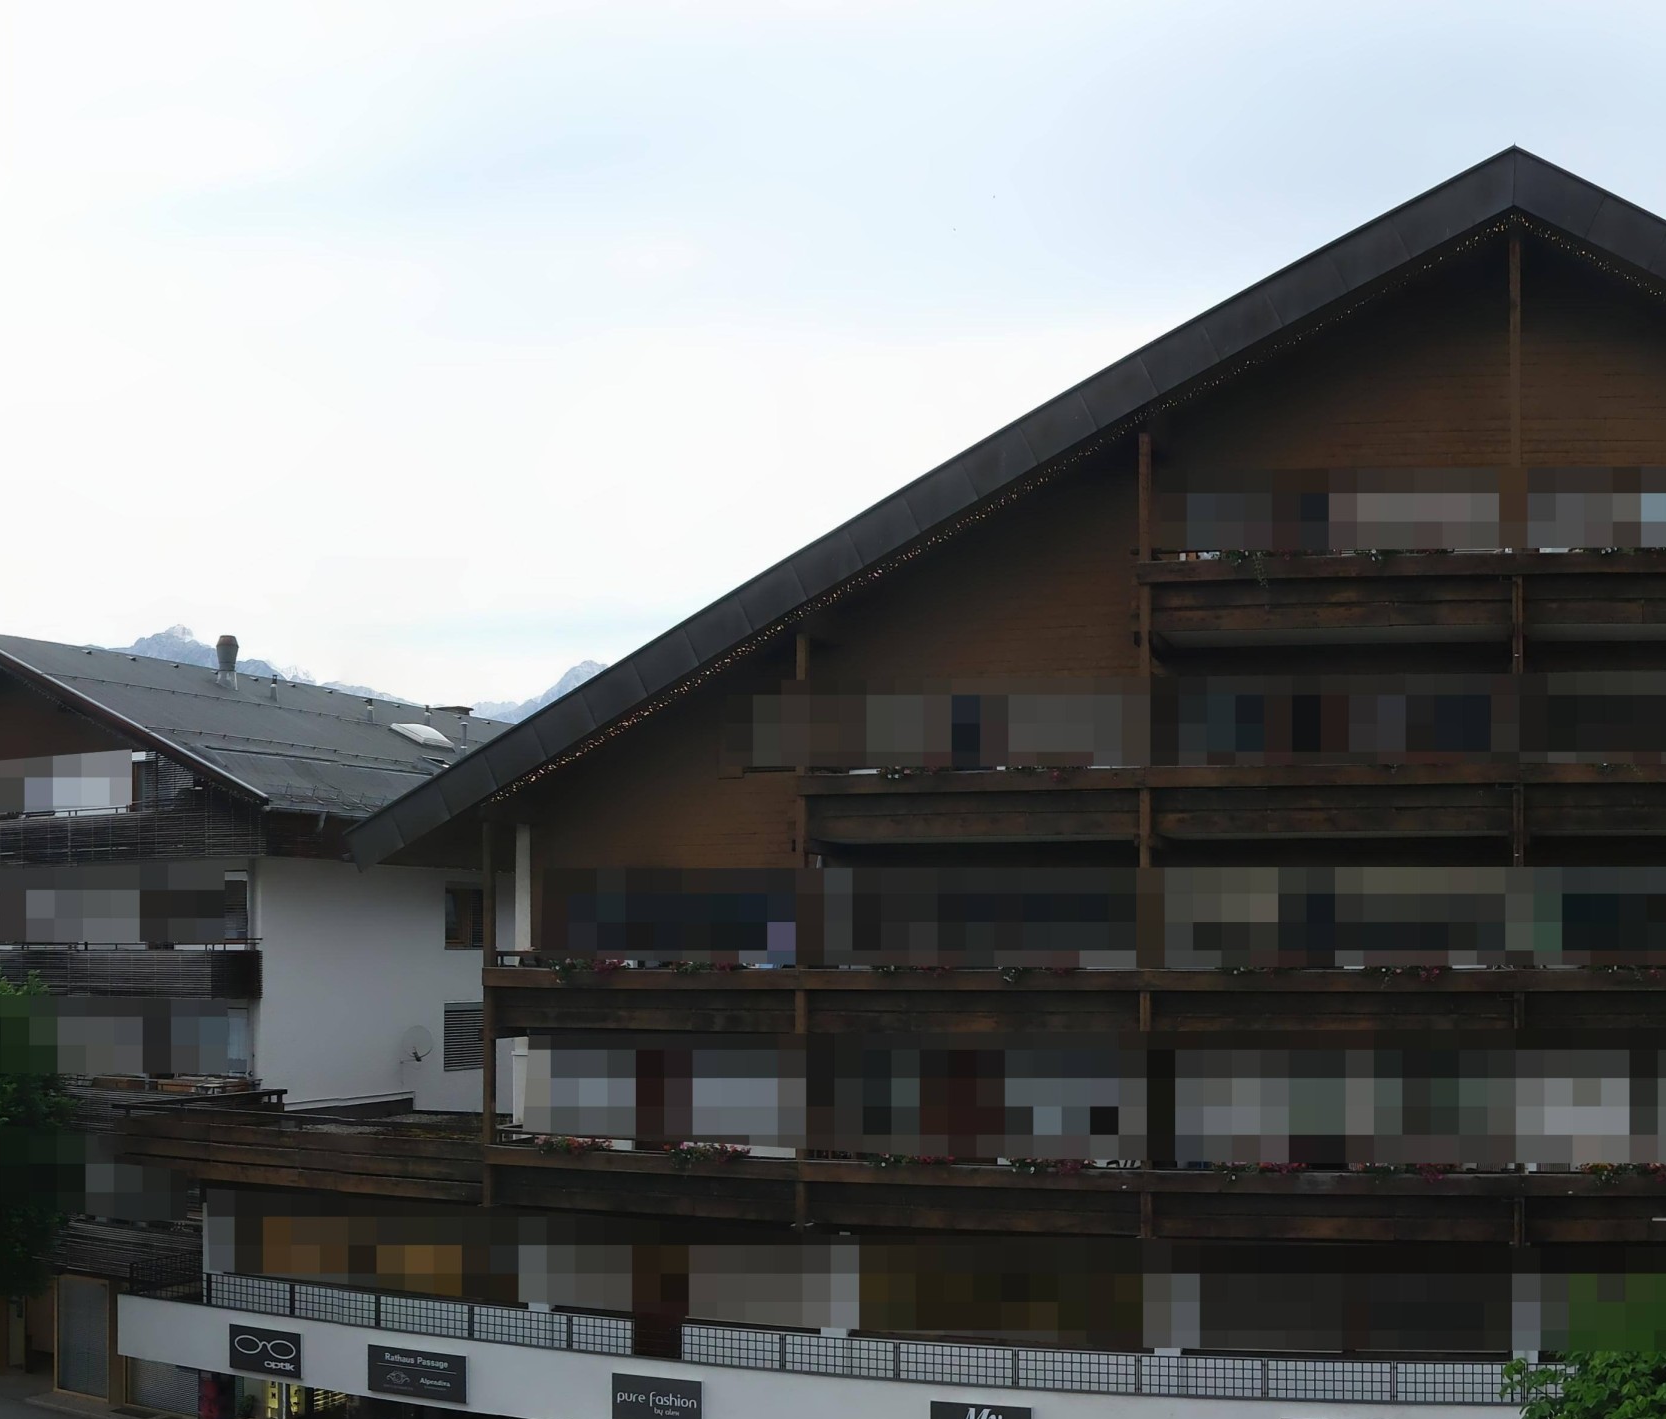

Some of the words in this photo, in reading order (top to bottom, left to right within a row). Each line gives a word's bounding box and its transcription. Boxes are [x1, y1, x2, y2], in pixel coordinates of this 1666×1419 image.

[264, 1361, 295, 1372] optik
[384, 1353, 415, 1364] Rathaus
[417, 1357, 449, 1370] Passage
[617, 1392, 646, 1404] pure
[649, 1391, 697, 1409] fashion
